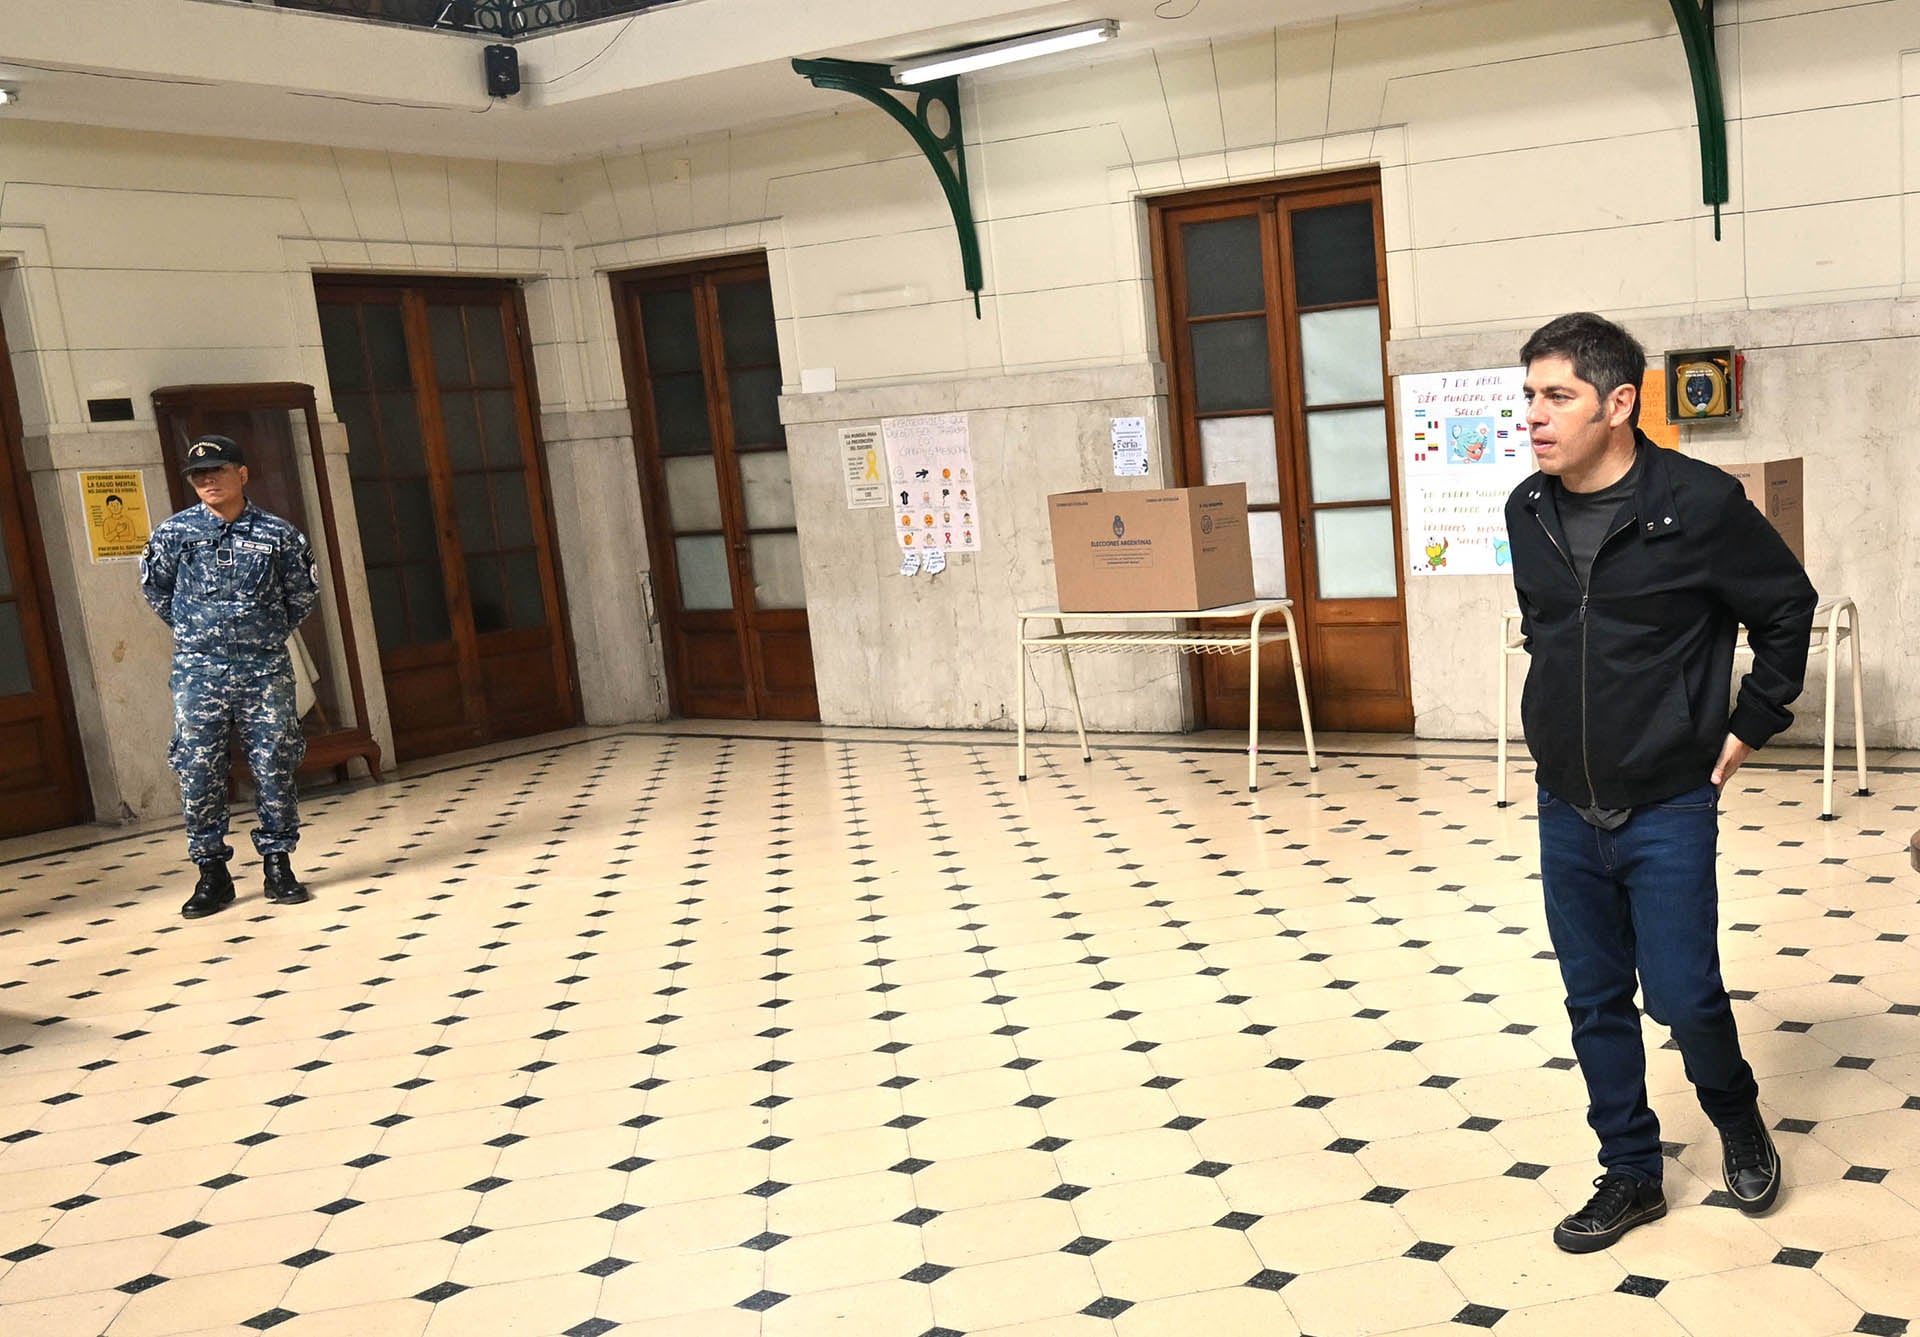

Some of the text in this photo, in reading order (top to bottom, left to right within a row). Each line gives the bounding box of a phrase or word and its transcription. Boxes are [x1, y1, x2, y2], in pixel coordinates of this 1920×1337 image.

[1441, 376, 1503, 389] 7 DE ABRIL
[1443, 392, 1485, 403] MUNDIAL
